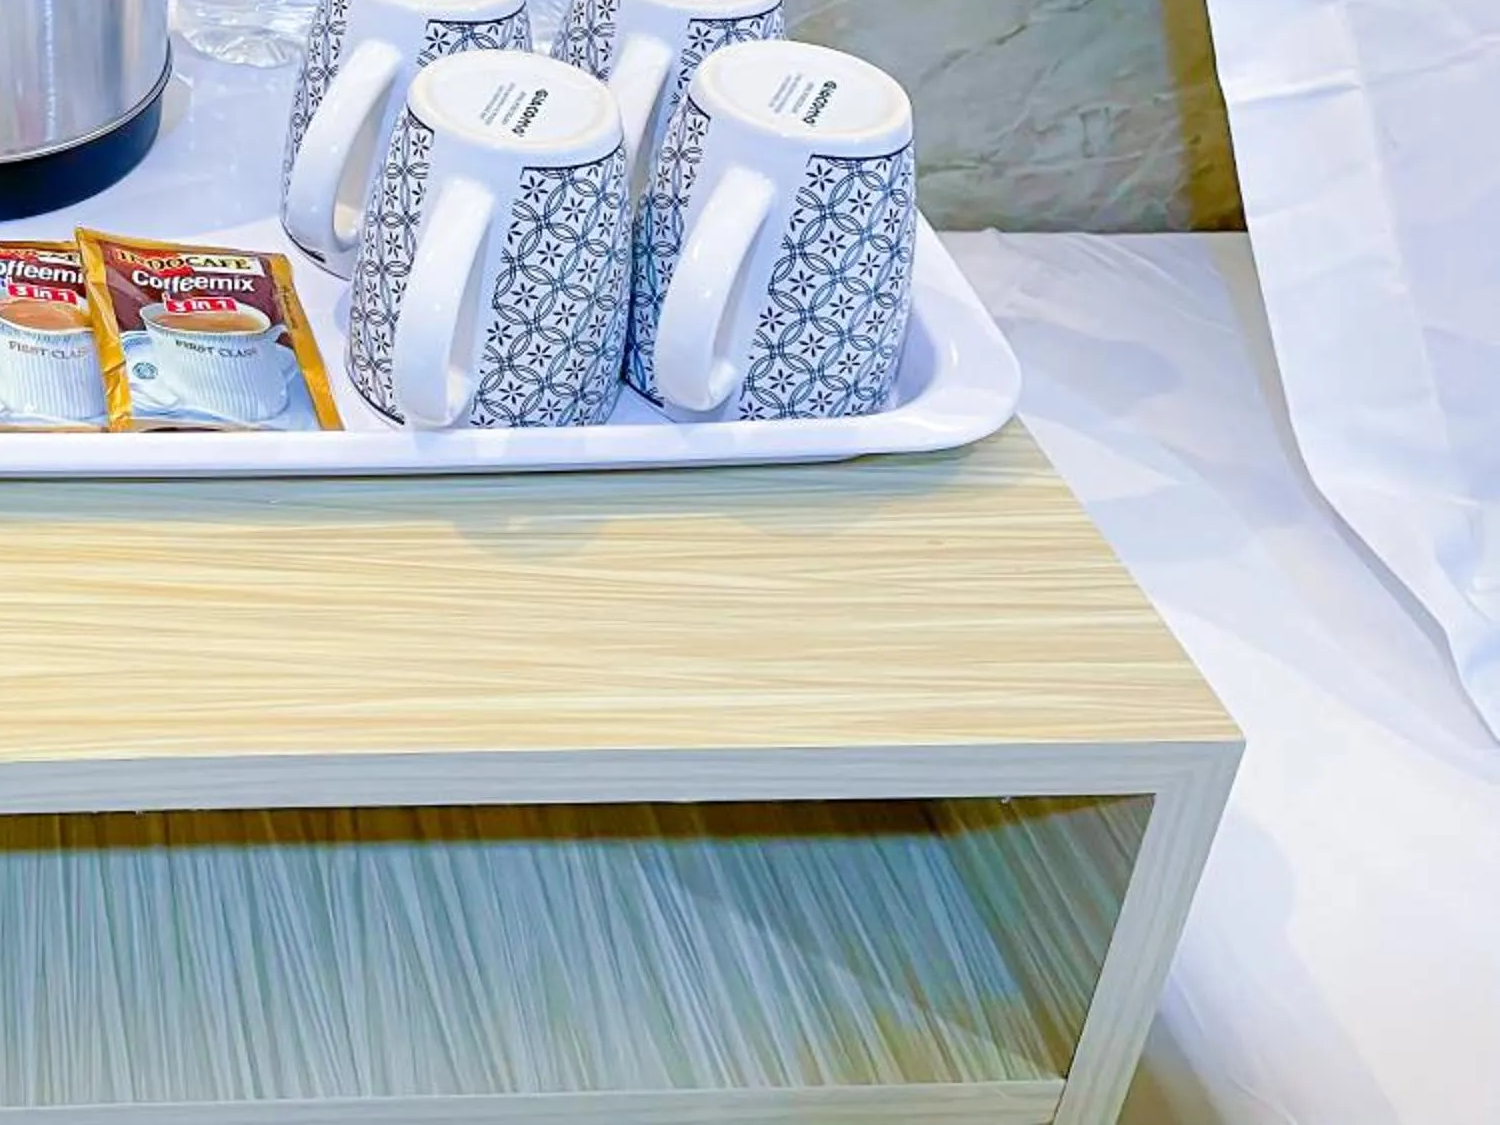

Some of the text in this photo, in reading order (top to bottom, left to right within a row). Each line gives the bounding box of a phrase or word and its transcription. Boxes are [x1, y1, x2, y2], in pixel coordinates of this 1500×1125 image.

[131, 270, 256, 293] Coffeemix
[17, 285, 28, 296] 3
[33, 287, 52, 299] in
[191, 299, 212, 311] in
